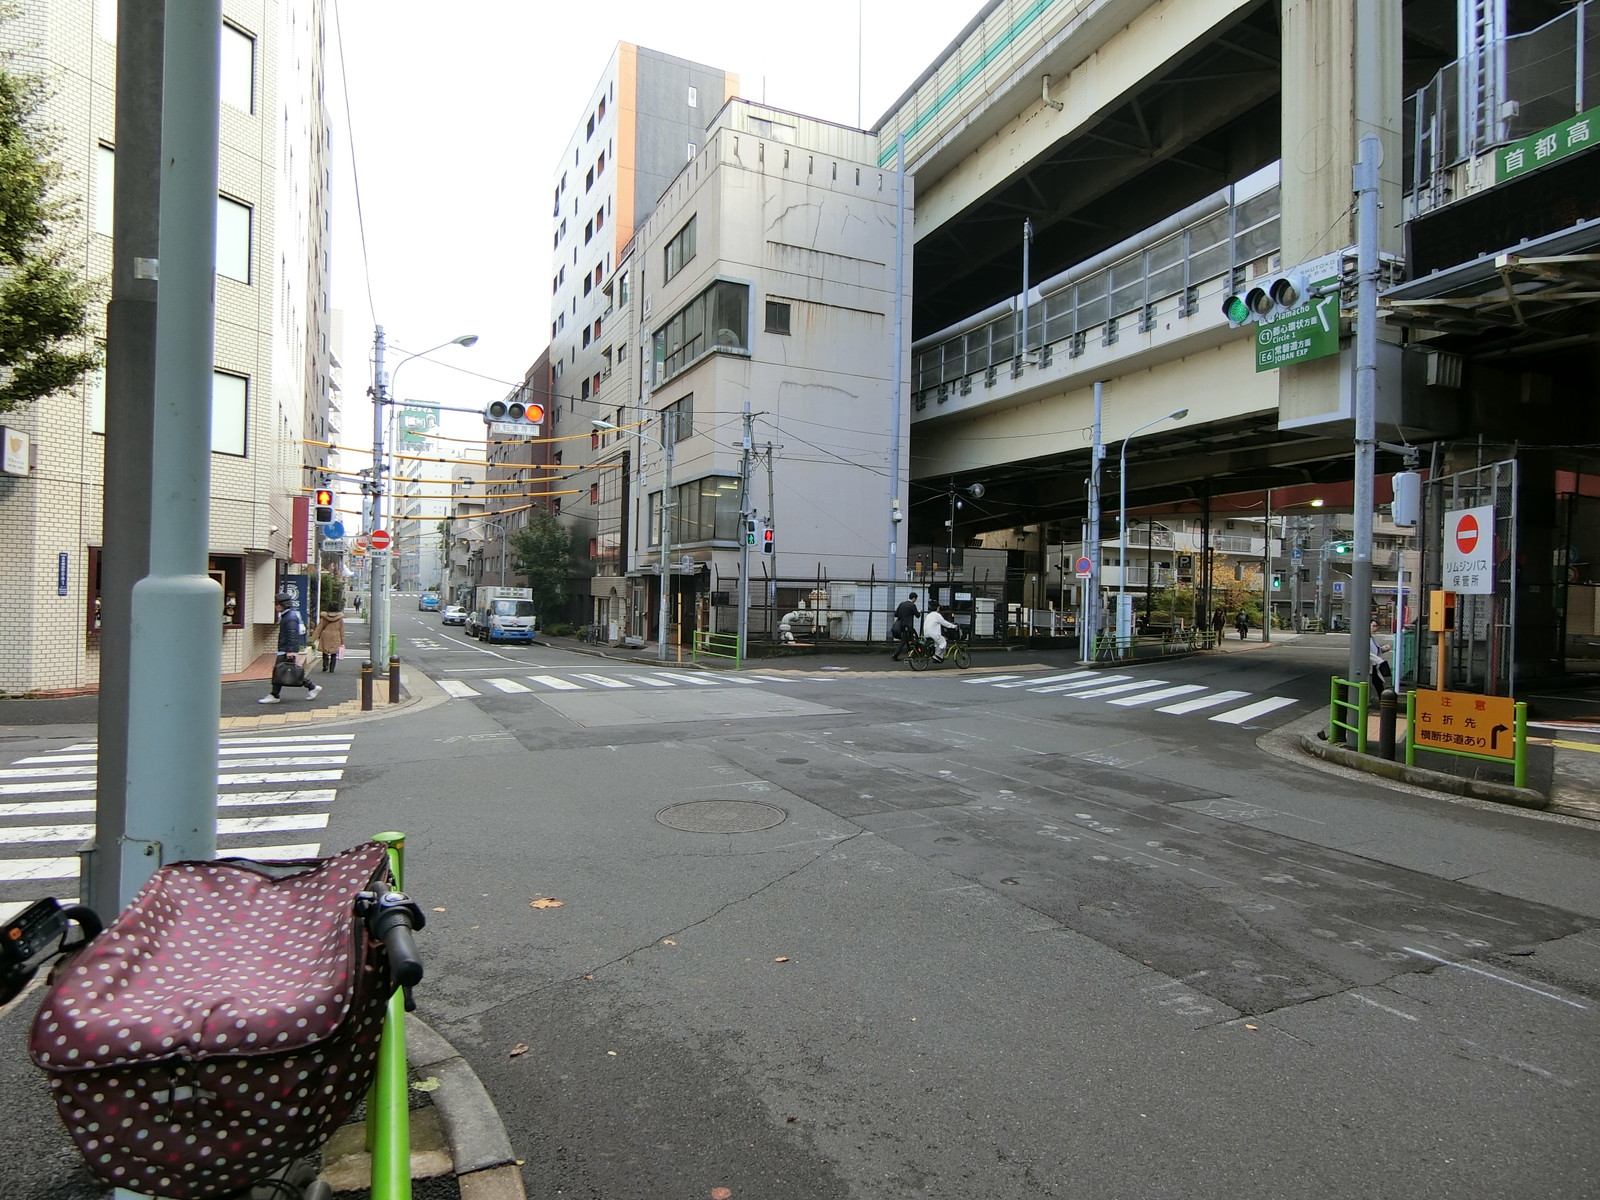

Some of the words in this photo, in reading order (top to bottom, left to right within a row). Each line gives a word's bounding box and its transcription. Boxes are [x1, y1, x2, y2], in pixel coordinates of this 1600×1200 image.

[1504, 119, 1590, 173] 首都高
[1272, 333, 1291, 344] Circle
[1261, 351, 1272, 363] E6
[1274, 351, 1295, 364] JOBAN
[1296, 348, 1309, 357] EXP
[1180, 557, 1190, 568] P
[1446, 560, 1487, 573] リムジンバス
[1453, 575, 1479, 587] 保管所
[1440, 696, 1486, 711] 注意
[1421, 712, 1477, 729] 右折先
[1420, 729, 1486, 748] 横断歩道あり
